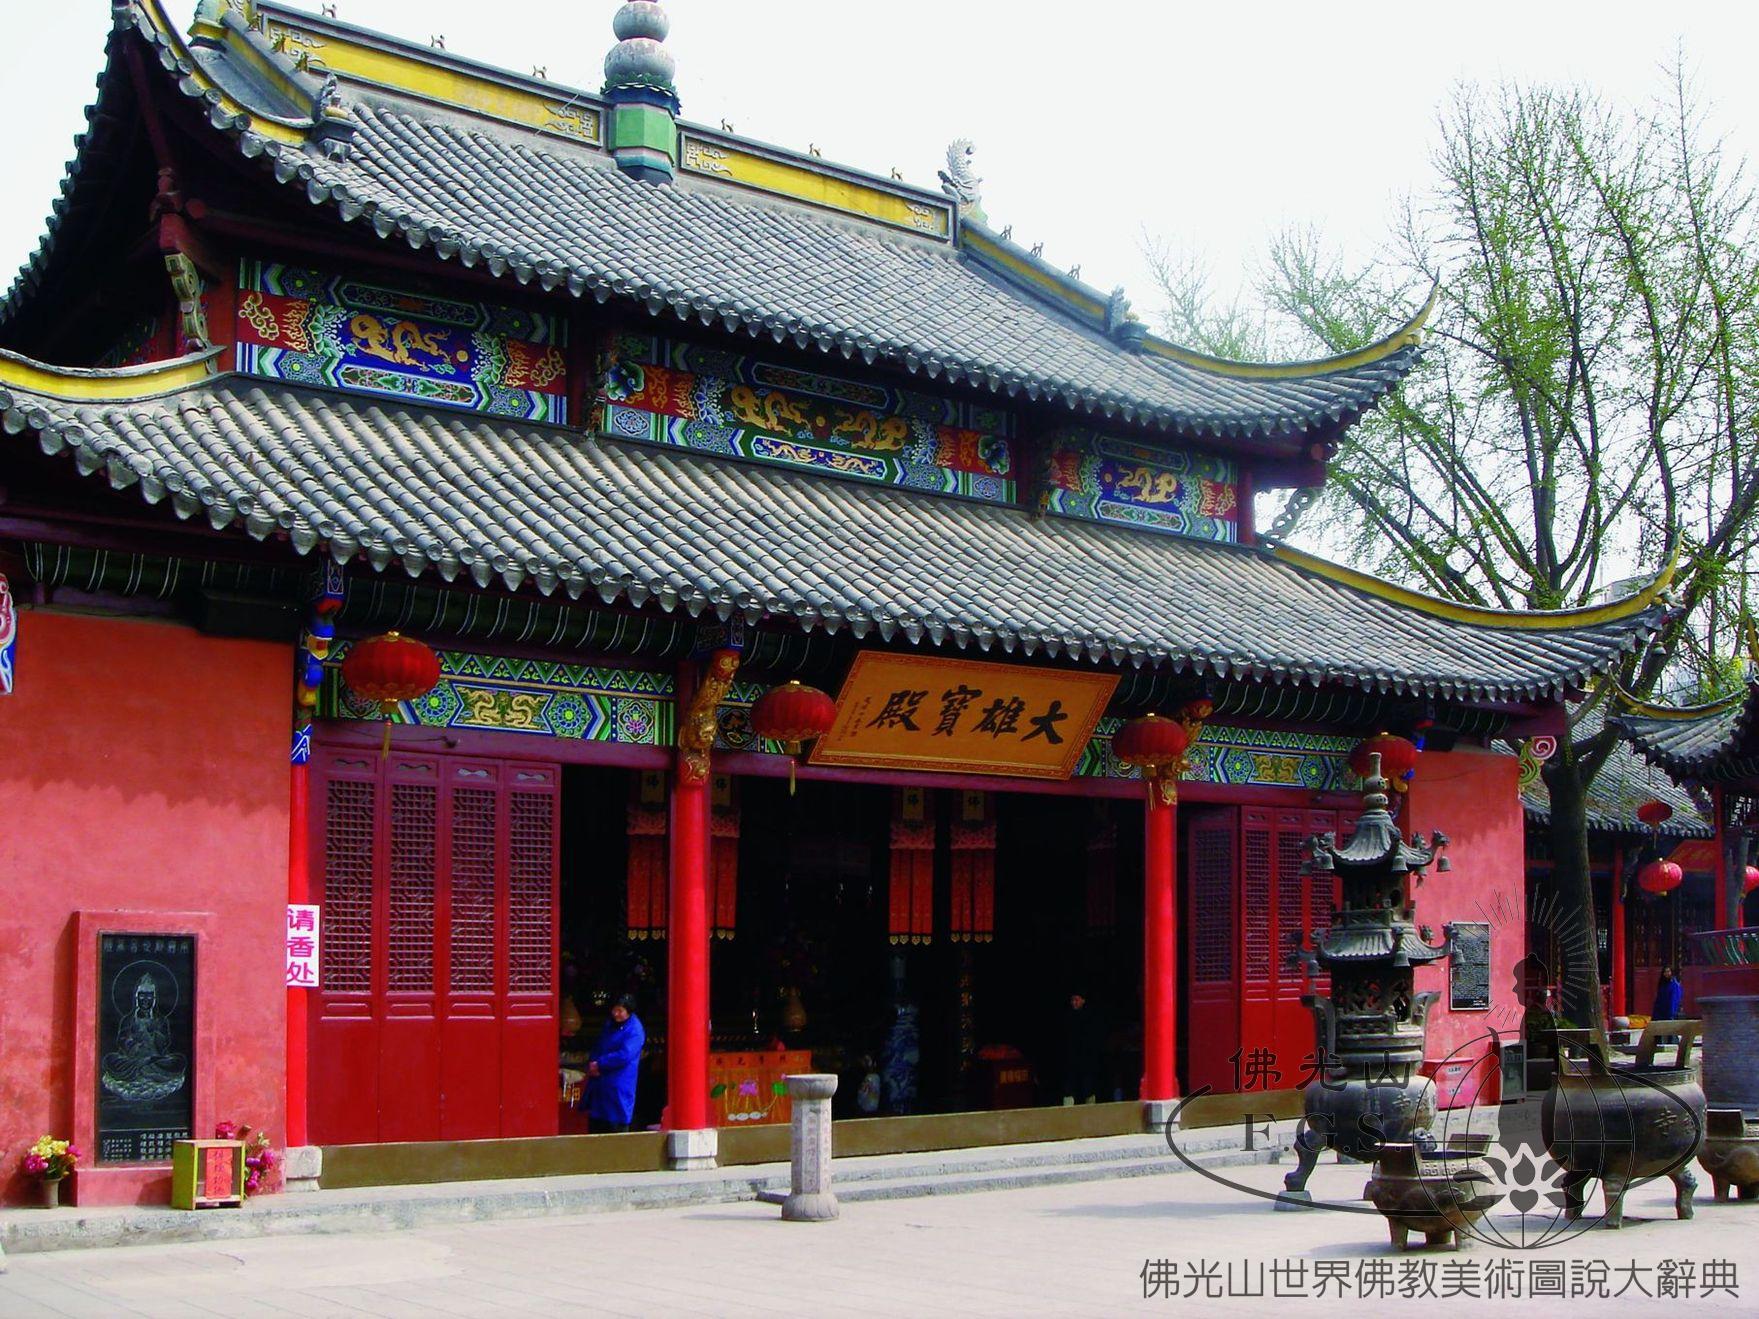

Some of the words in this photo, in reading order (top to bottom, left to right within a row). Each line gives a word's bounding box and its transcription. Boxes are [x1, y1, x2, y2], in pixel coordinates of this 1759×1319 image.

[866, 684, 1069, 745] 大雄寶殿
[287, 909, 315, 983] 请香处
